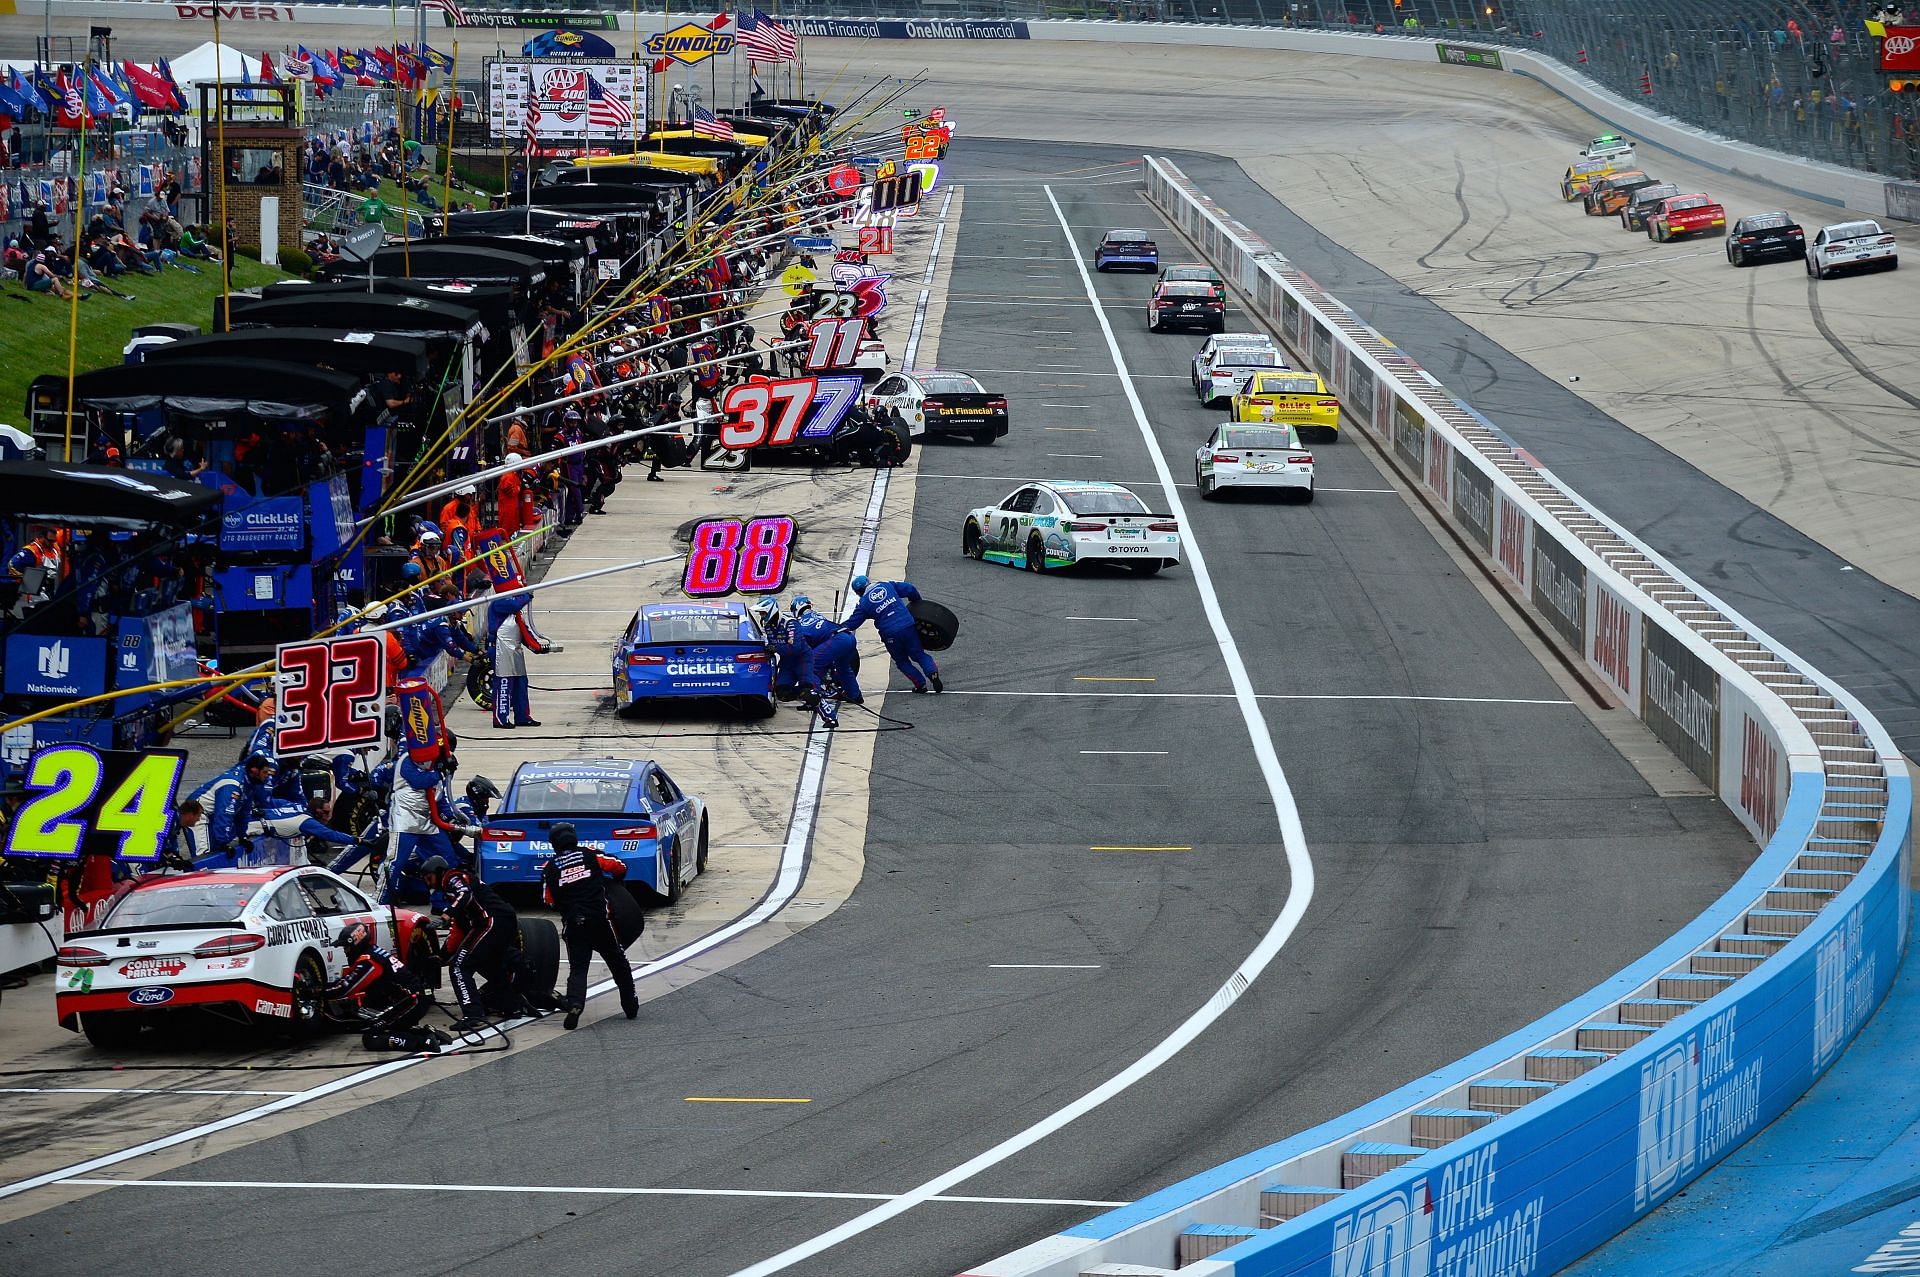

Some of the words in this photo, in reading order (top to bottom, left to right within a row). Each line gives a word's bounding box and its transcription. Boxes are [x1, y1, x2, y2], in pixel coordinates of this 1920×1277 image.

[175, 5, 279, 21] DOVER
[555, 34, 584, 43] SUNOCO
[785, 21, 828, 37] eMain
[829, 21, 880, 38] Financial
[905, 21, 964, 39] OneMain
[966, 22, 1016, 40] Financial
[651, 36, 732, 52] SUNOCO
[545, 70, 578, 89] AAA
[561, 90, 586, 99] 400
[905, 135, 941, 160] 22
[860, 228, 892, 254] 21
[812, 292, 858, 320] 23
[805, 317, 867, 370] 11
[720, 376, 818, 450] 37
[940, 407, 954, 415] Cat
[956, 407, 993, 415] Financial
[452, 447, 470, 459] 11
[246, 513, 299, 524] ClickList
[683, 517, 796, 596] 88
[122, 634, 141, 648] 88
[666, 663, 735, 676] ClickList
[27, 683, 78, 695] Nationwide
[278, 638, 379, 750] 32
[1648, 648, 1676, 720] PROTECT
[1682, 679, 1713, 758] HARVEST
[410, 698, 428, 743] SUNOCO
[519, 770, 630, 781] Nationwide
[4, 744, 184, 862] 24
[529, 840, 606, 851] Natwide
[621, 840, 639, 852] 88
[266, 919, 330, 947] CORVETTEPARTS
[127, 957, 181, 970] CORVETTE
[136, 988, 165, 1002] Ford
[1702, 1004, 1738, 1090] OFFICE
[1700, 1055, 1764, 1166] TECHNOLOGY
[1438, 1140, 1499, 1243] OFFICE
